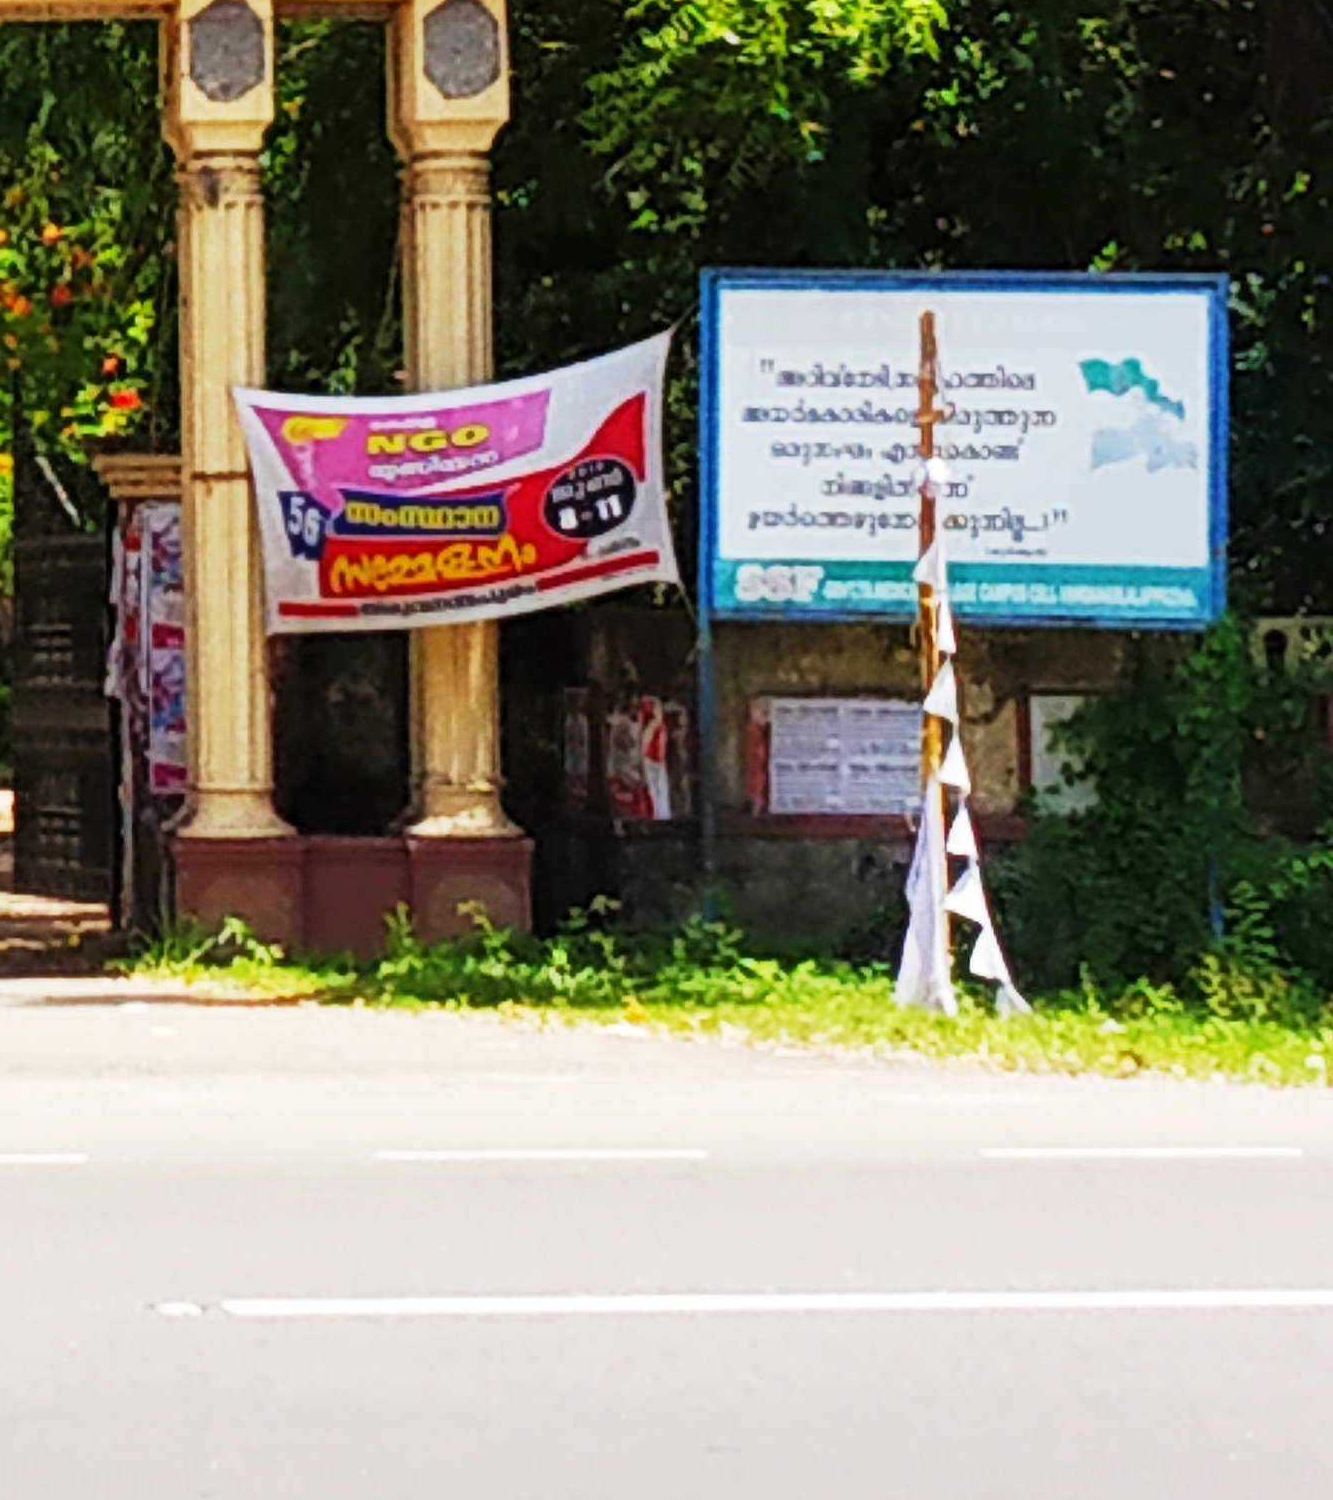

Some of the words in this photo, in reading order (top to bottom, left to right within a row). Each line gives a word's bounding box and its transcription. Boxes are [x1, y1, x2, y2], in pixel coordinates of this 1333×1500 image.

[367, 424, 489, 455] NGO
[285, 498, 322, 547] 56
[557, 506, 579, 530] 8
